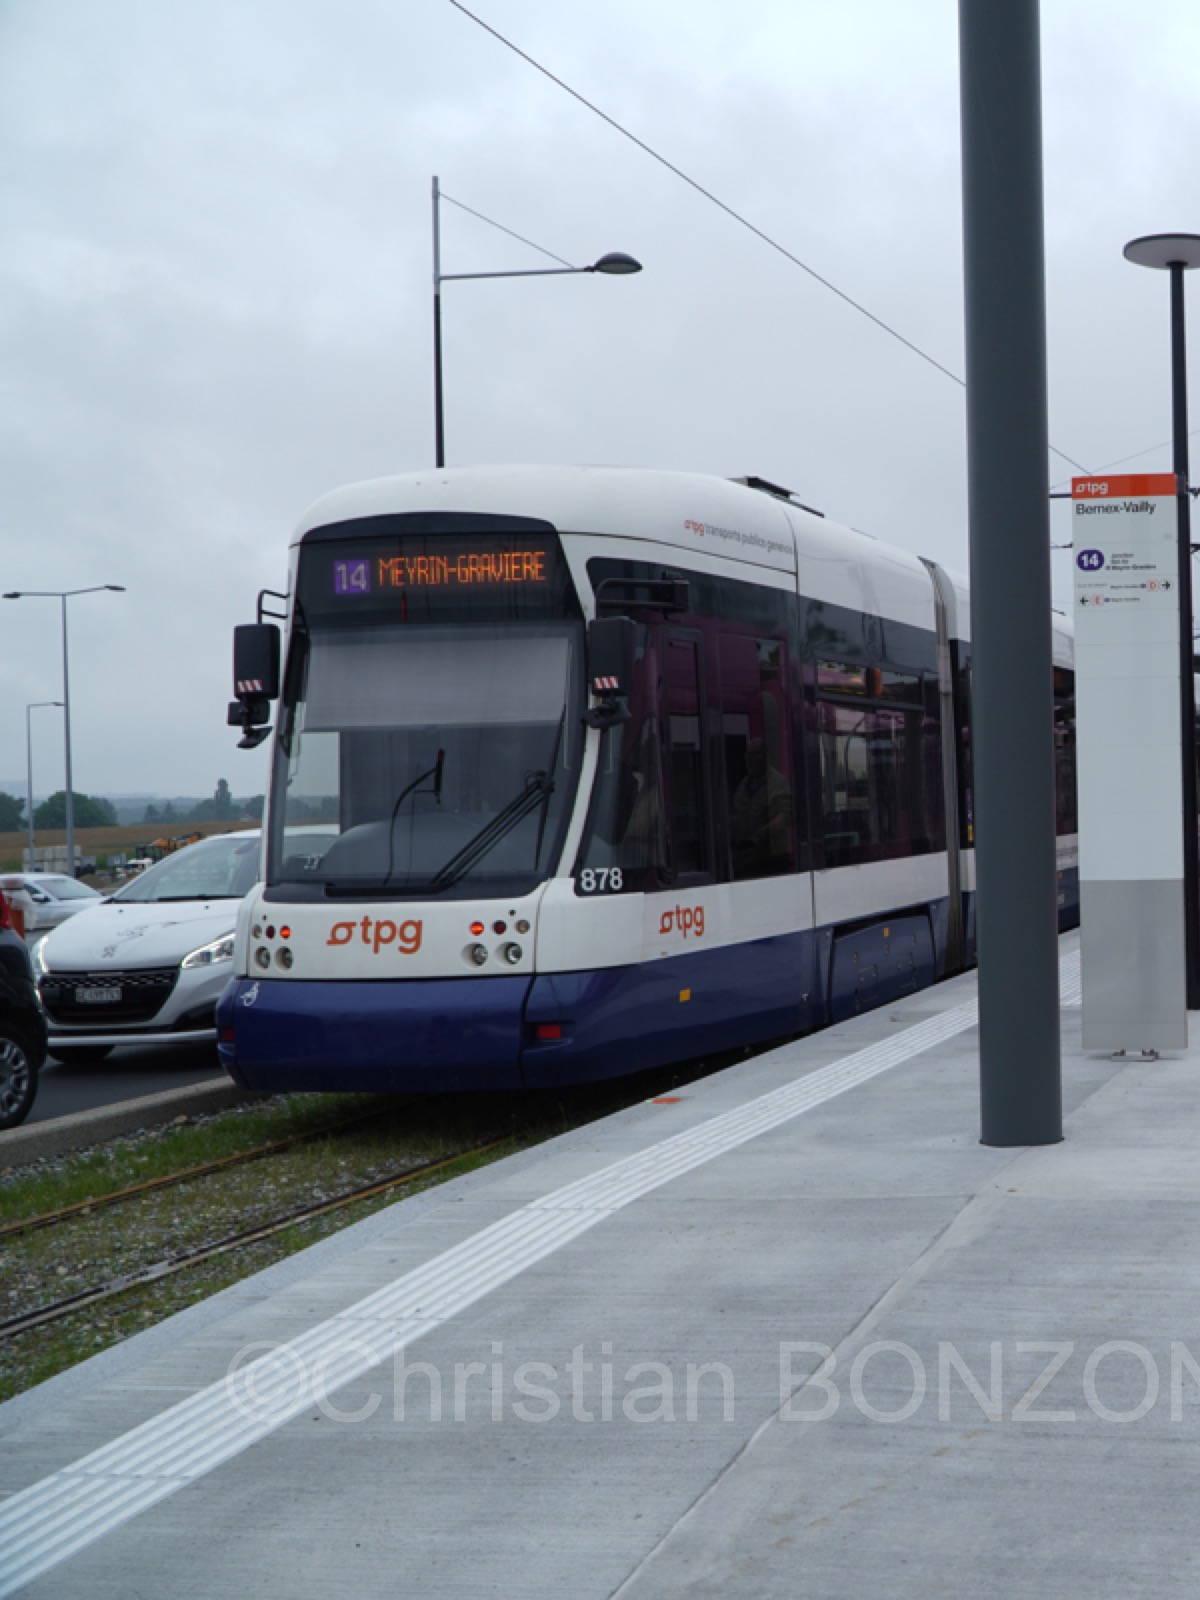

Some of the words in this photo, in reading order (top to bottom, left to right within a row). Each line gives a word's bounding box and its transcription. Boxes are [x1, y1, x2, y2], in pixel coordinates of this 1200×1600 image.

[1087, 482, 1109, 495] tpg
[336, 563, 367, 591] 14
[378, 552, 546, 587] MEYRIN-GRAVIERE
[1081, 552, 1100, 568] 14
[581, 867, 623, 892] 878
[360, 915, 423, 954] tpg
[675, 904, 705, 939] tpg
